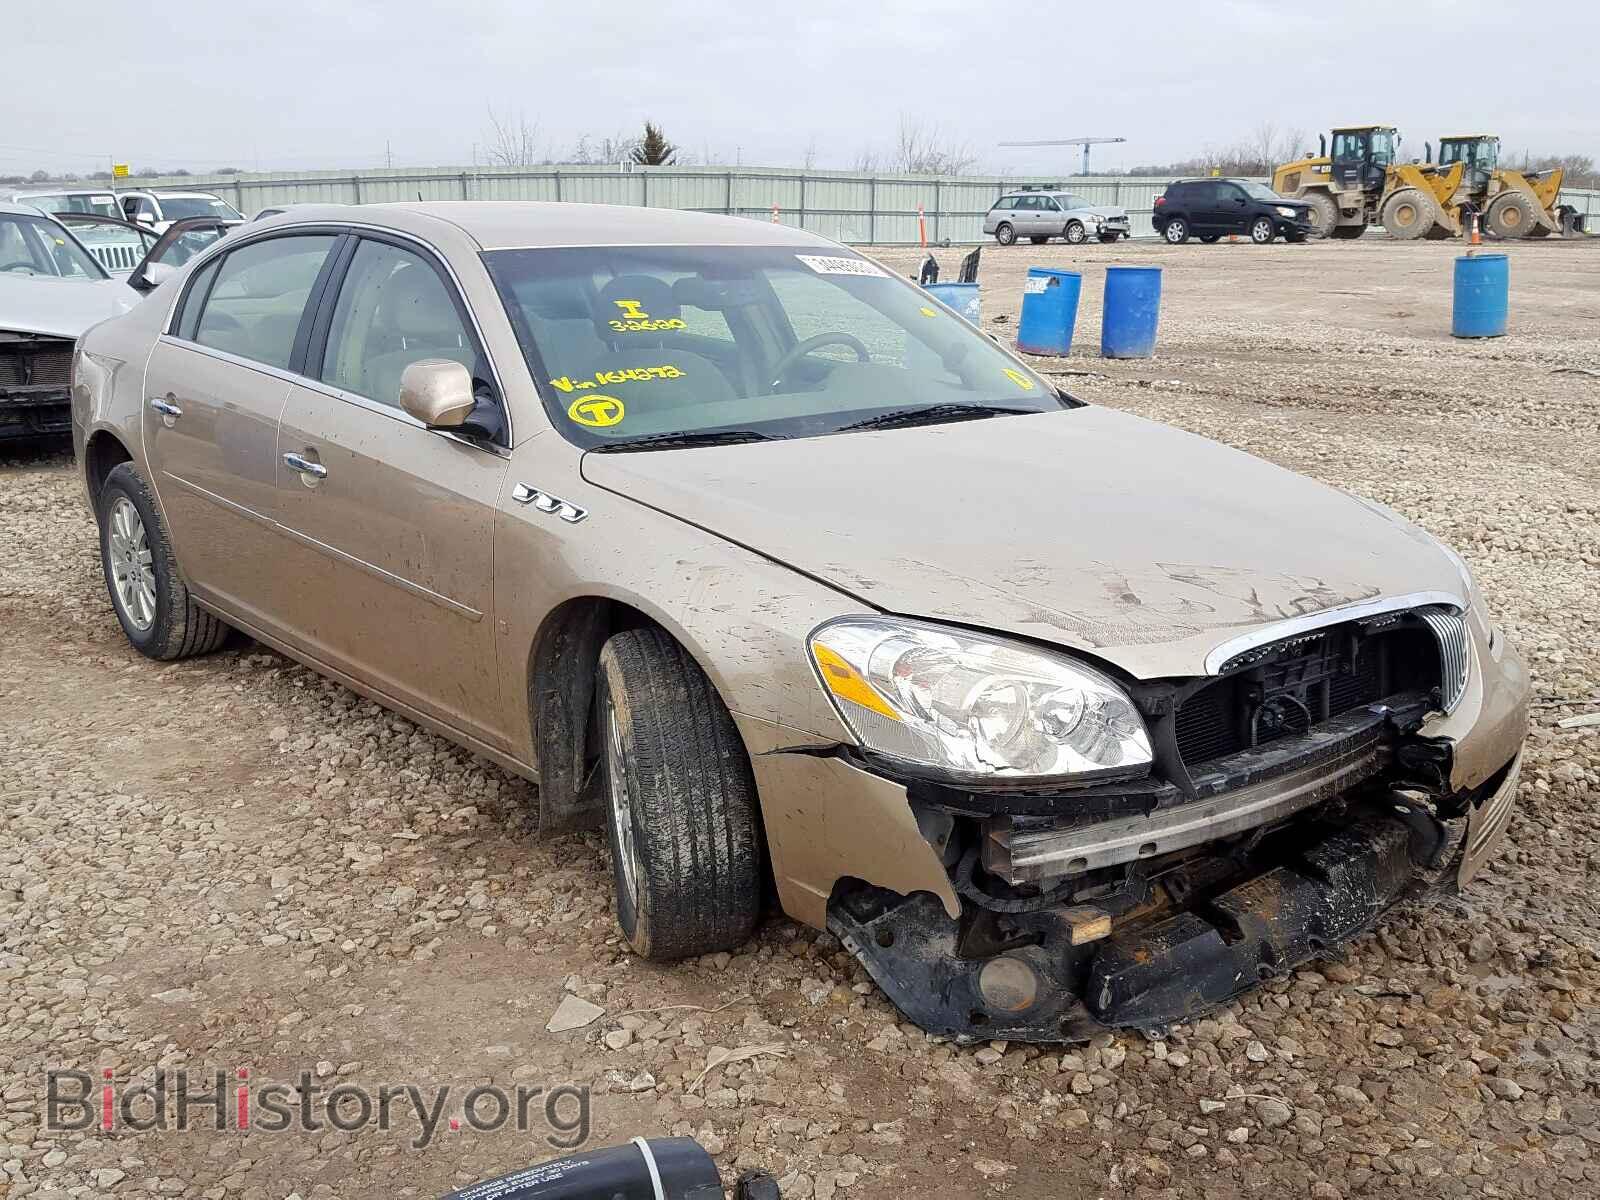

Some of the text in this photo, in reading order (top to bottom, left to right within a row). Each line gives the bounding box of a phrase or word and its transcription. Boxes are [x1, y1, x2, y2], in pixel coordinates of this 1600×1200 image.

[595, 365, 687, 385] 164272
[459, 1179, 504, 1199] CHARGE
[464, 1184, 511, 1200] CHARGE
[511, 1172, 546, 1186] EVERY
[561, 1160, 590, 1171] DAYS
[485, 1172, 565, 1200] OR AFTER USE
